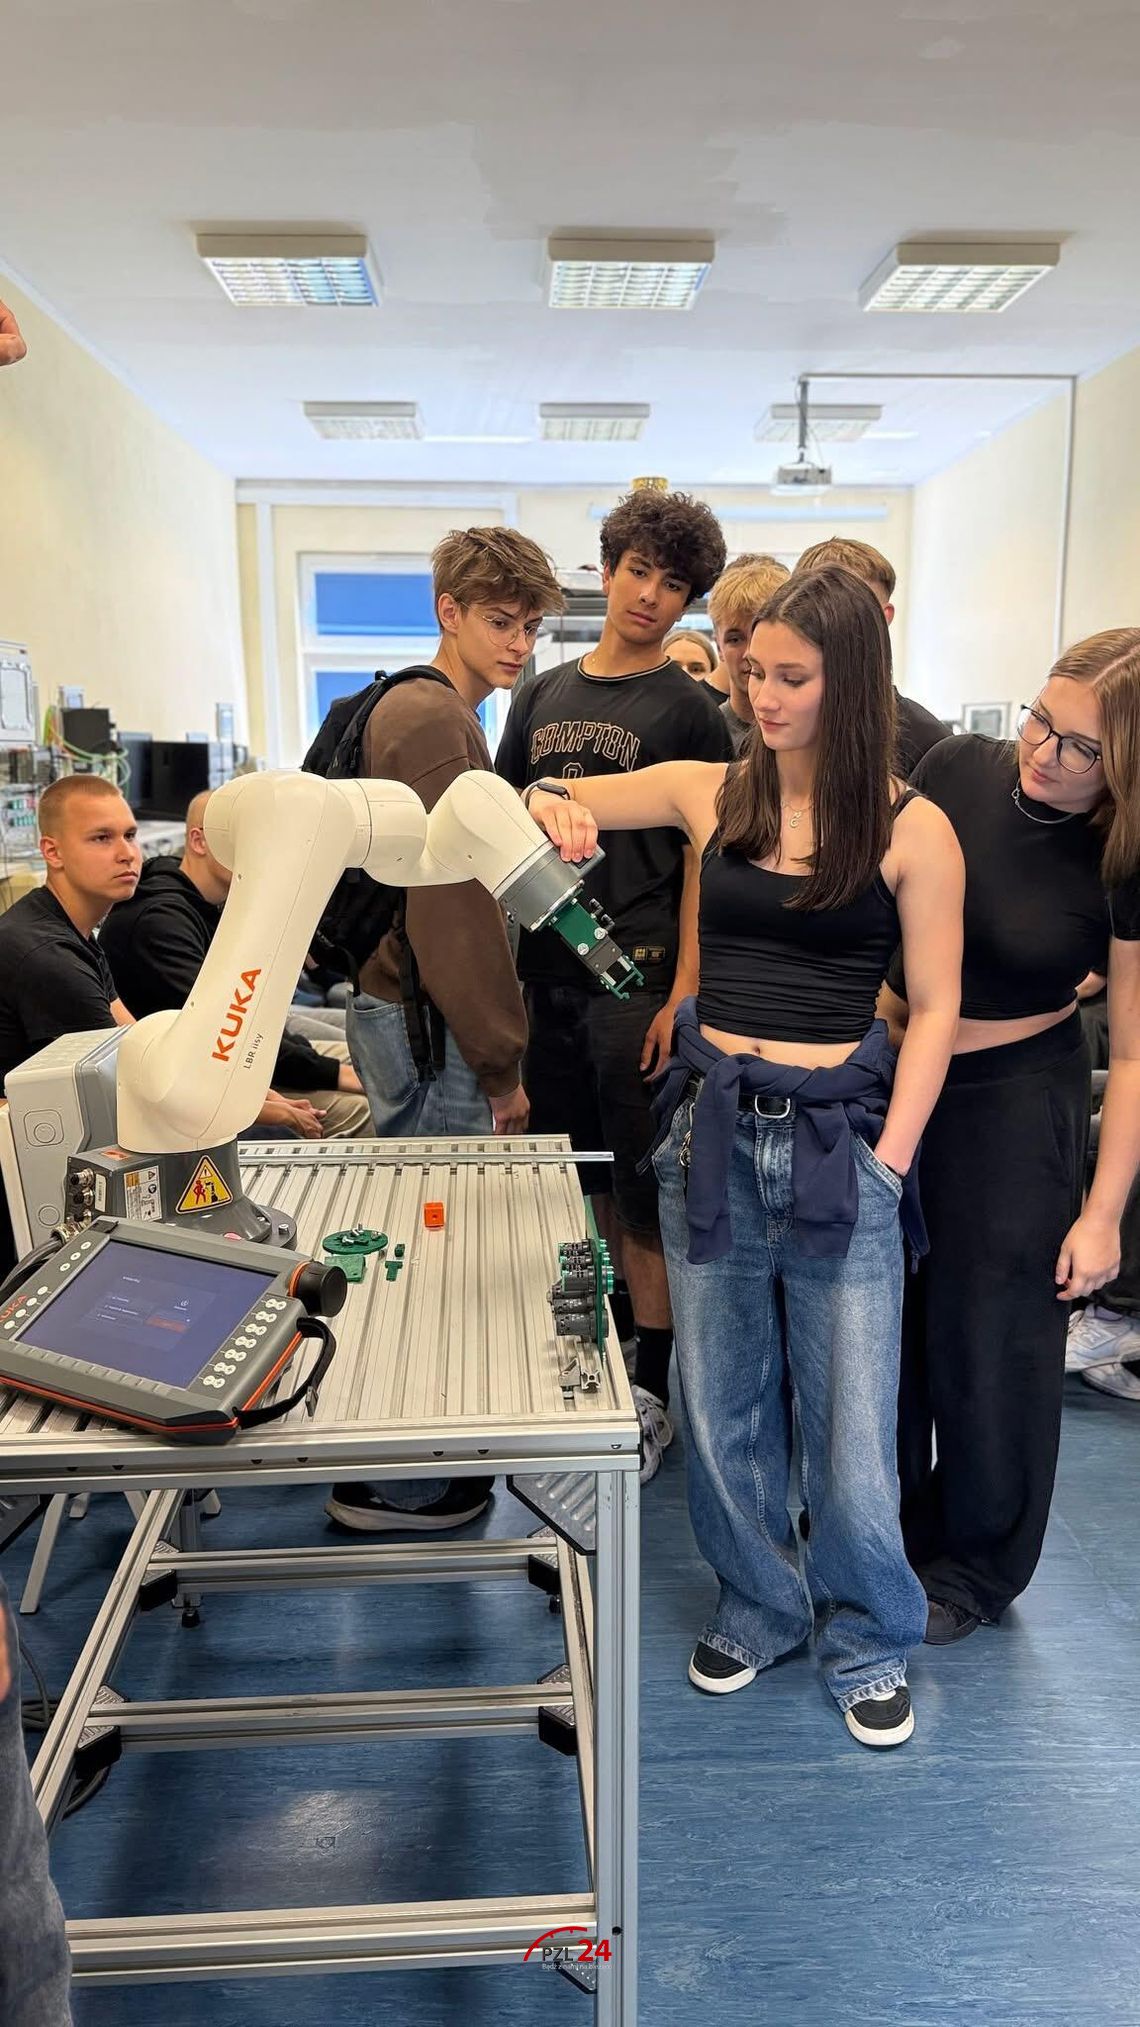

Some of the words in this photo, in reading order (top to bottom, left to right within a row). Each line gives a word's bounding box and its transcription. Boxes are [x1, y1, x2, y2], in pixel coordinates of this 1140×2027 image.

[531, 721, 640, 772] COMPTON
[212, 968, 262, 1062] KUKA
[243, 1050, 256, 1069] LBR
[0, 1295, 26, 1323] UKA
